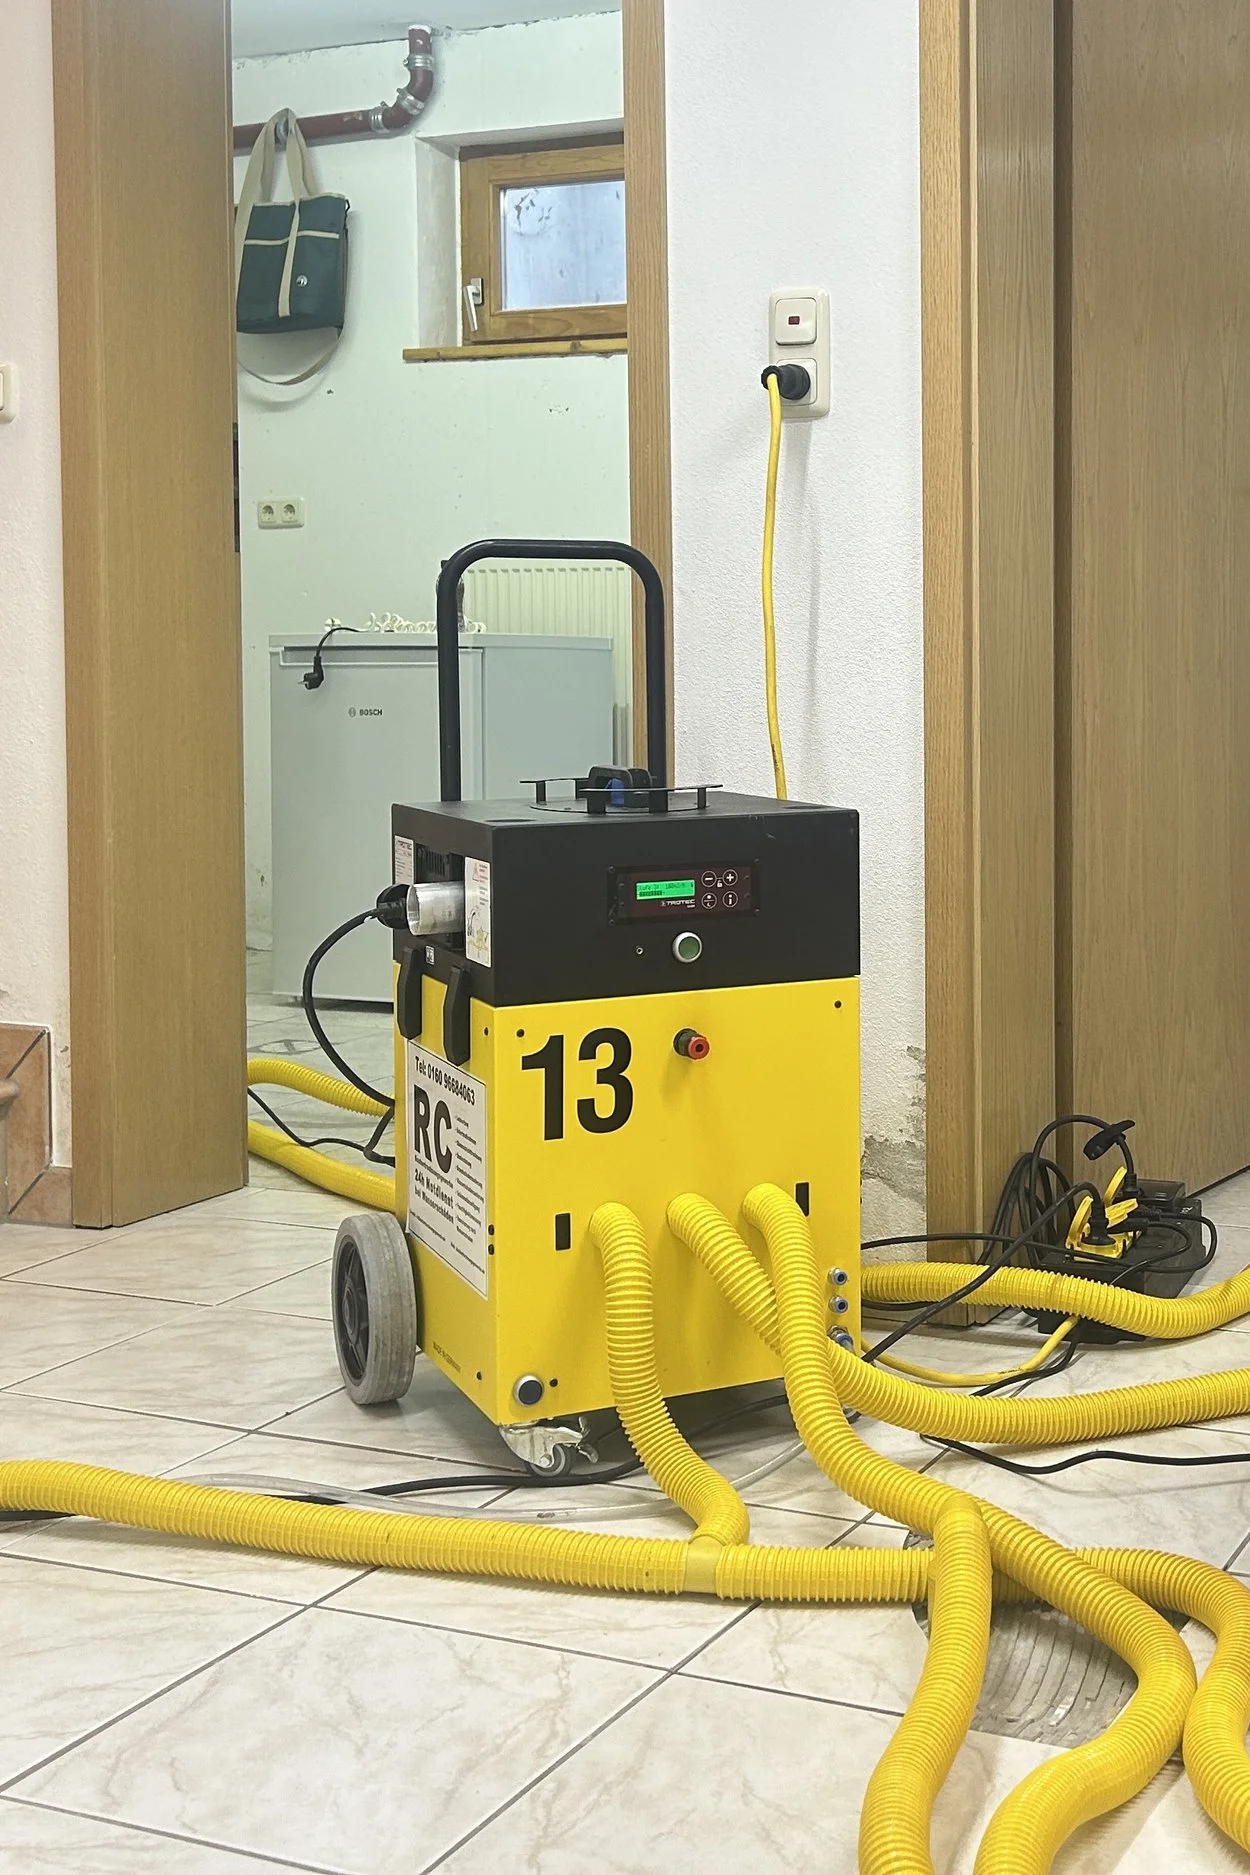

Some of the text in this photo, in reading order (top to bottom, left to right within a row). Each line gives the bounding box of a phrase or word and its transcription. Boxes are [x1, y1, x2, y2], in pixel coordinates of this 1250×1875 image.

[359, 708, 383, 716] BOSCH
[427, 1064, 443, 1086] 0160
[443, 1072, 475, 1106] 96684063
[521, 1027, 634, 1141] 13
[413, 1084, 453, 1174] RC
